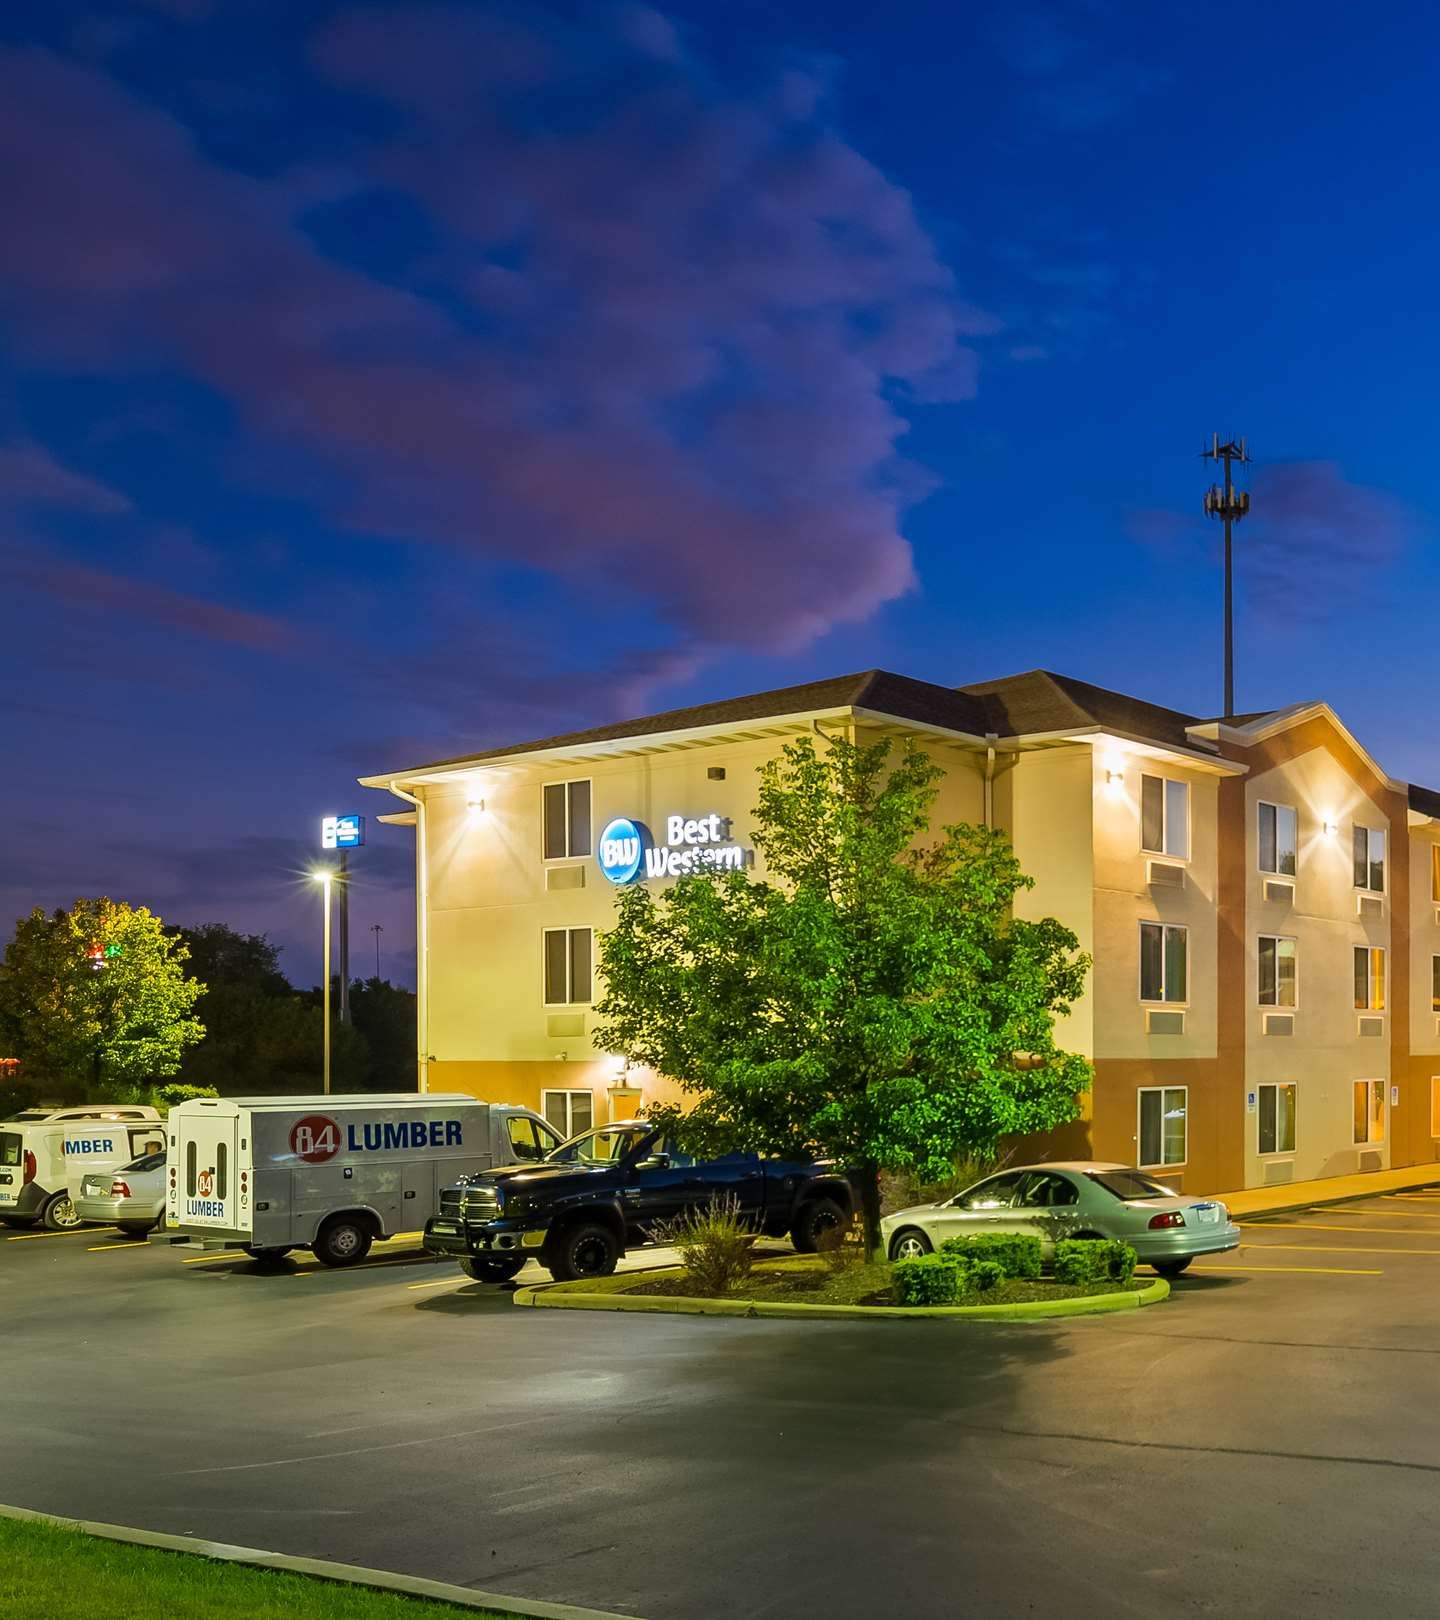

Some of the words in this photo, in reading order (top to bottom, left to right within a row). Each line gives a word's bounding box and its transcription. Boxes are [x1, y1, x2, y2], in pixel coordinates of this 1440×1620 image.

[667, 813, 721, 847] Best
[603, 837, 638, 868] BW
[65, 1139, 114, 1155] MBER
[296, 1125, 336, 1155] 84
[347, 1120, 463, 1152] LUMBER
[199, 1175, 212, 1193] 84
[186, 1199, 224, 1218] LUMBER
